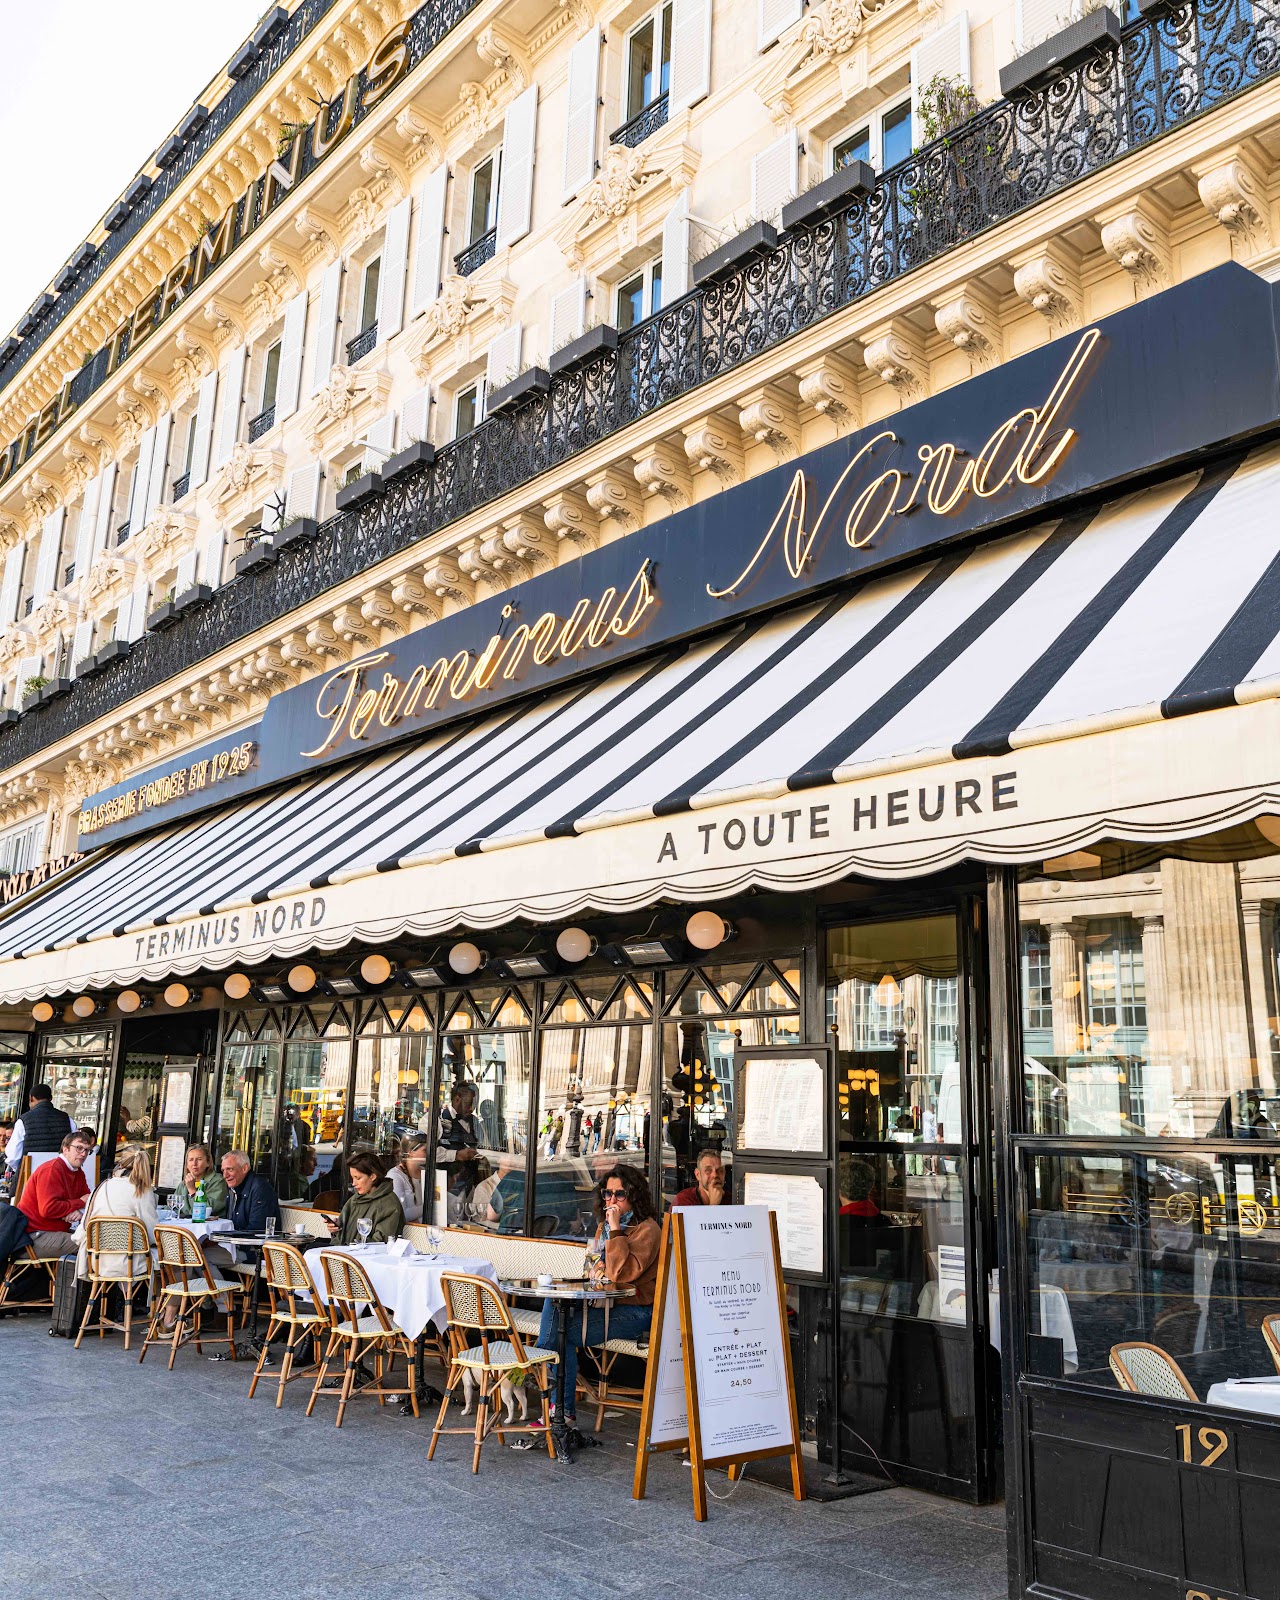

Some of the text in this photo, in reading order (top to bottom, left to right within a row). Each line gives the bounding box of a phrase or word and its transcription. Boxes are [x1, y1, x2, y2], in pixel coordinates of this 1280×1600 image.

[105, 20, 412, 376] TERMINUS
[300, 328, 1102, 757] Terminus Nord
[77, 788, 137, 836] BRASSERIE
[188, 759, 209, 791] EN
[211, 741, 253, 783] 1925
[656, 771, 1019, 864] A TOUTE HEURE
[135, 897, 326, 962] TERMINUS NORD
[700, 1221, 753, 1231] TERMINUS NORD
[702, 1282, 762, 1297] TERMINUS NORD
[721, 1270, 741, 1281] MENU
[713, 1343, 739, 1353] ENTRÉE
[746, 1341, 762, 1349] PLAT
[715, 1353, 732, 1361] PLAT
[739, 1349, 768, 1358] DESSERT
[730, 1378, 752, 1388] 24,50
[1175, 1423, 1229, 1467] 19
